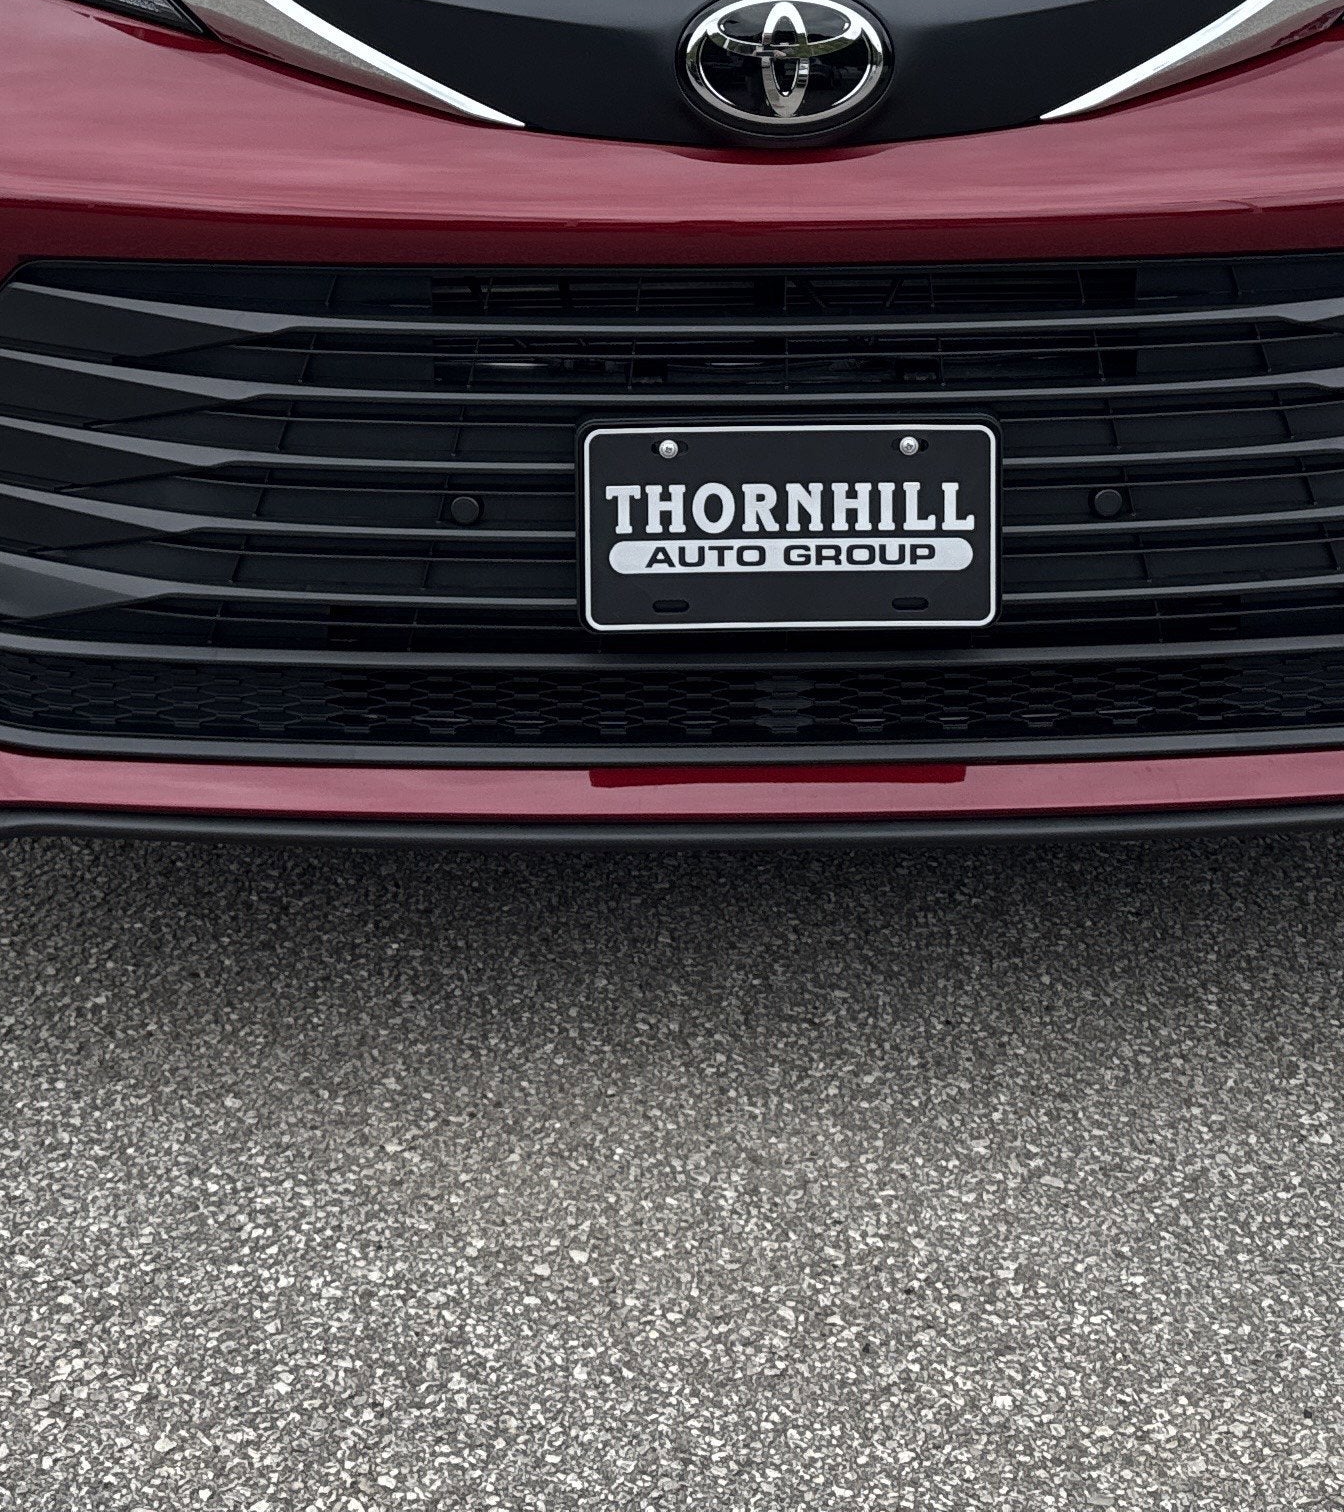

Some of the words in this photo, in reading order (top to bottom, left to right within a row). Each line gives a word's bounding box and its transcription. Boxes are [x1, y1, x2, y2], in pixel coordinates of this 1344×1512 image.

[605, 481, 975, 534] THORNHILL
[645, 545, 766, 568] AUTO
[783, 543, 936, 566] GROUP
